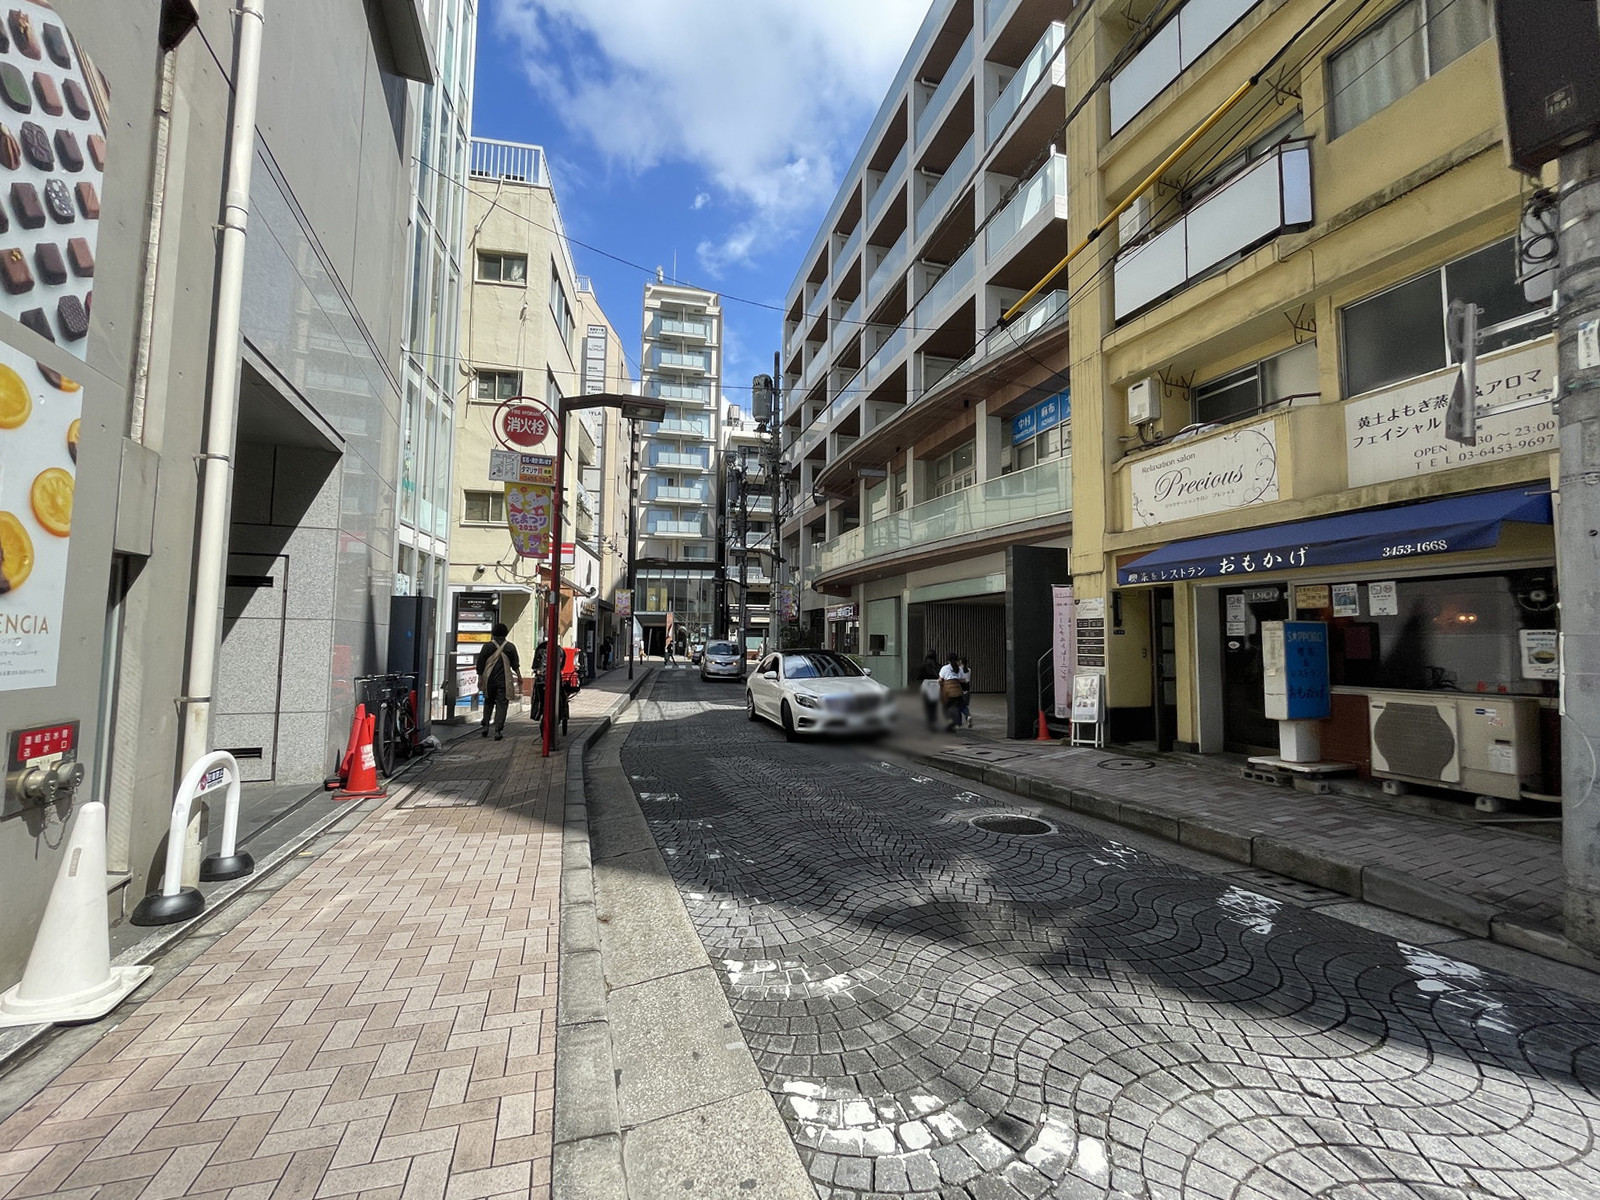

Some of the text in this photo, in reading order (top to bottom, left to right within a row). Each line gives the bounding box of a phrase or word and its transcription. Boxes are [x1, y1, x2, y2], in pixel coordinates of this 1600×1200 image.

[507, 416, 546, 436] 消火栓
[1413, 444, 1448, 458] OPEN
[1515, 420, 1555, 437] 23:00
[1458, 434, 1555, 461] 03-6453-9697
[1141, 452, 1196, 474] Relaxation salon
[1154, 464, 1243, 502] Precious
[510, 513, 547, 527] 花まつり
[1219, 545, 1310, 574] おもかげ
[1382, 539, 1448, 557] 3453-1668
